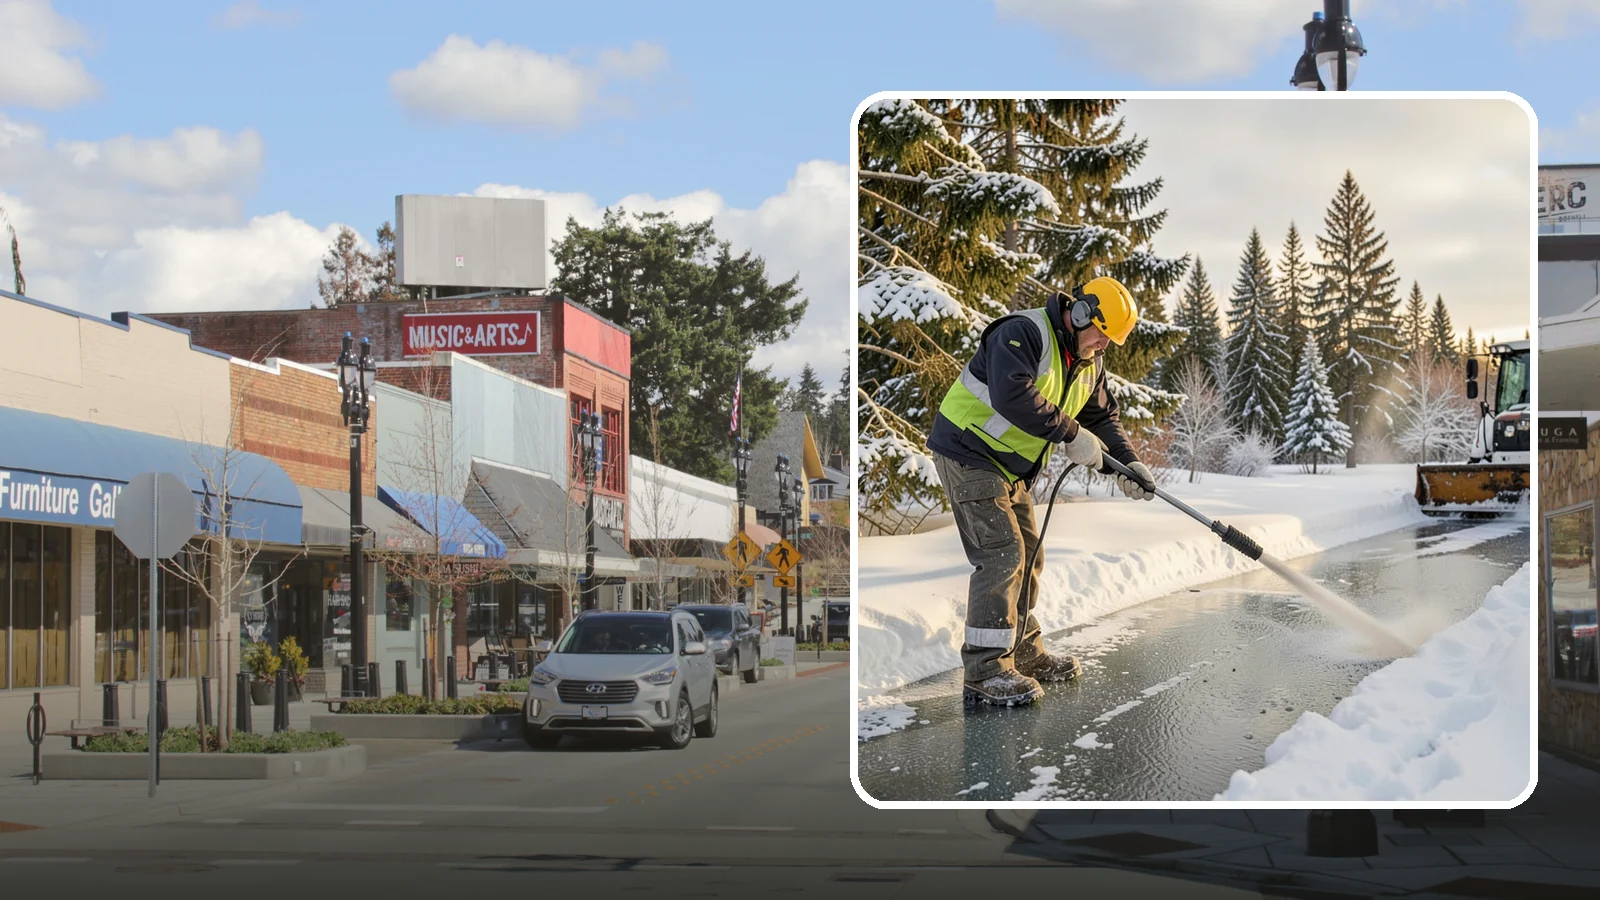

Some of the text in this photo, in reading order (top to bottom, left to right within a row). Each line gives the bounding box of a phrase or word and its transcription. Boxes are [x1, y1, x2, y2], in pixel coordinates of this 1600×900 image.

[0, 471, 122, 519] Furniture Gal
[453, 563, 479, 574] SUSHI
